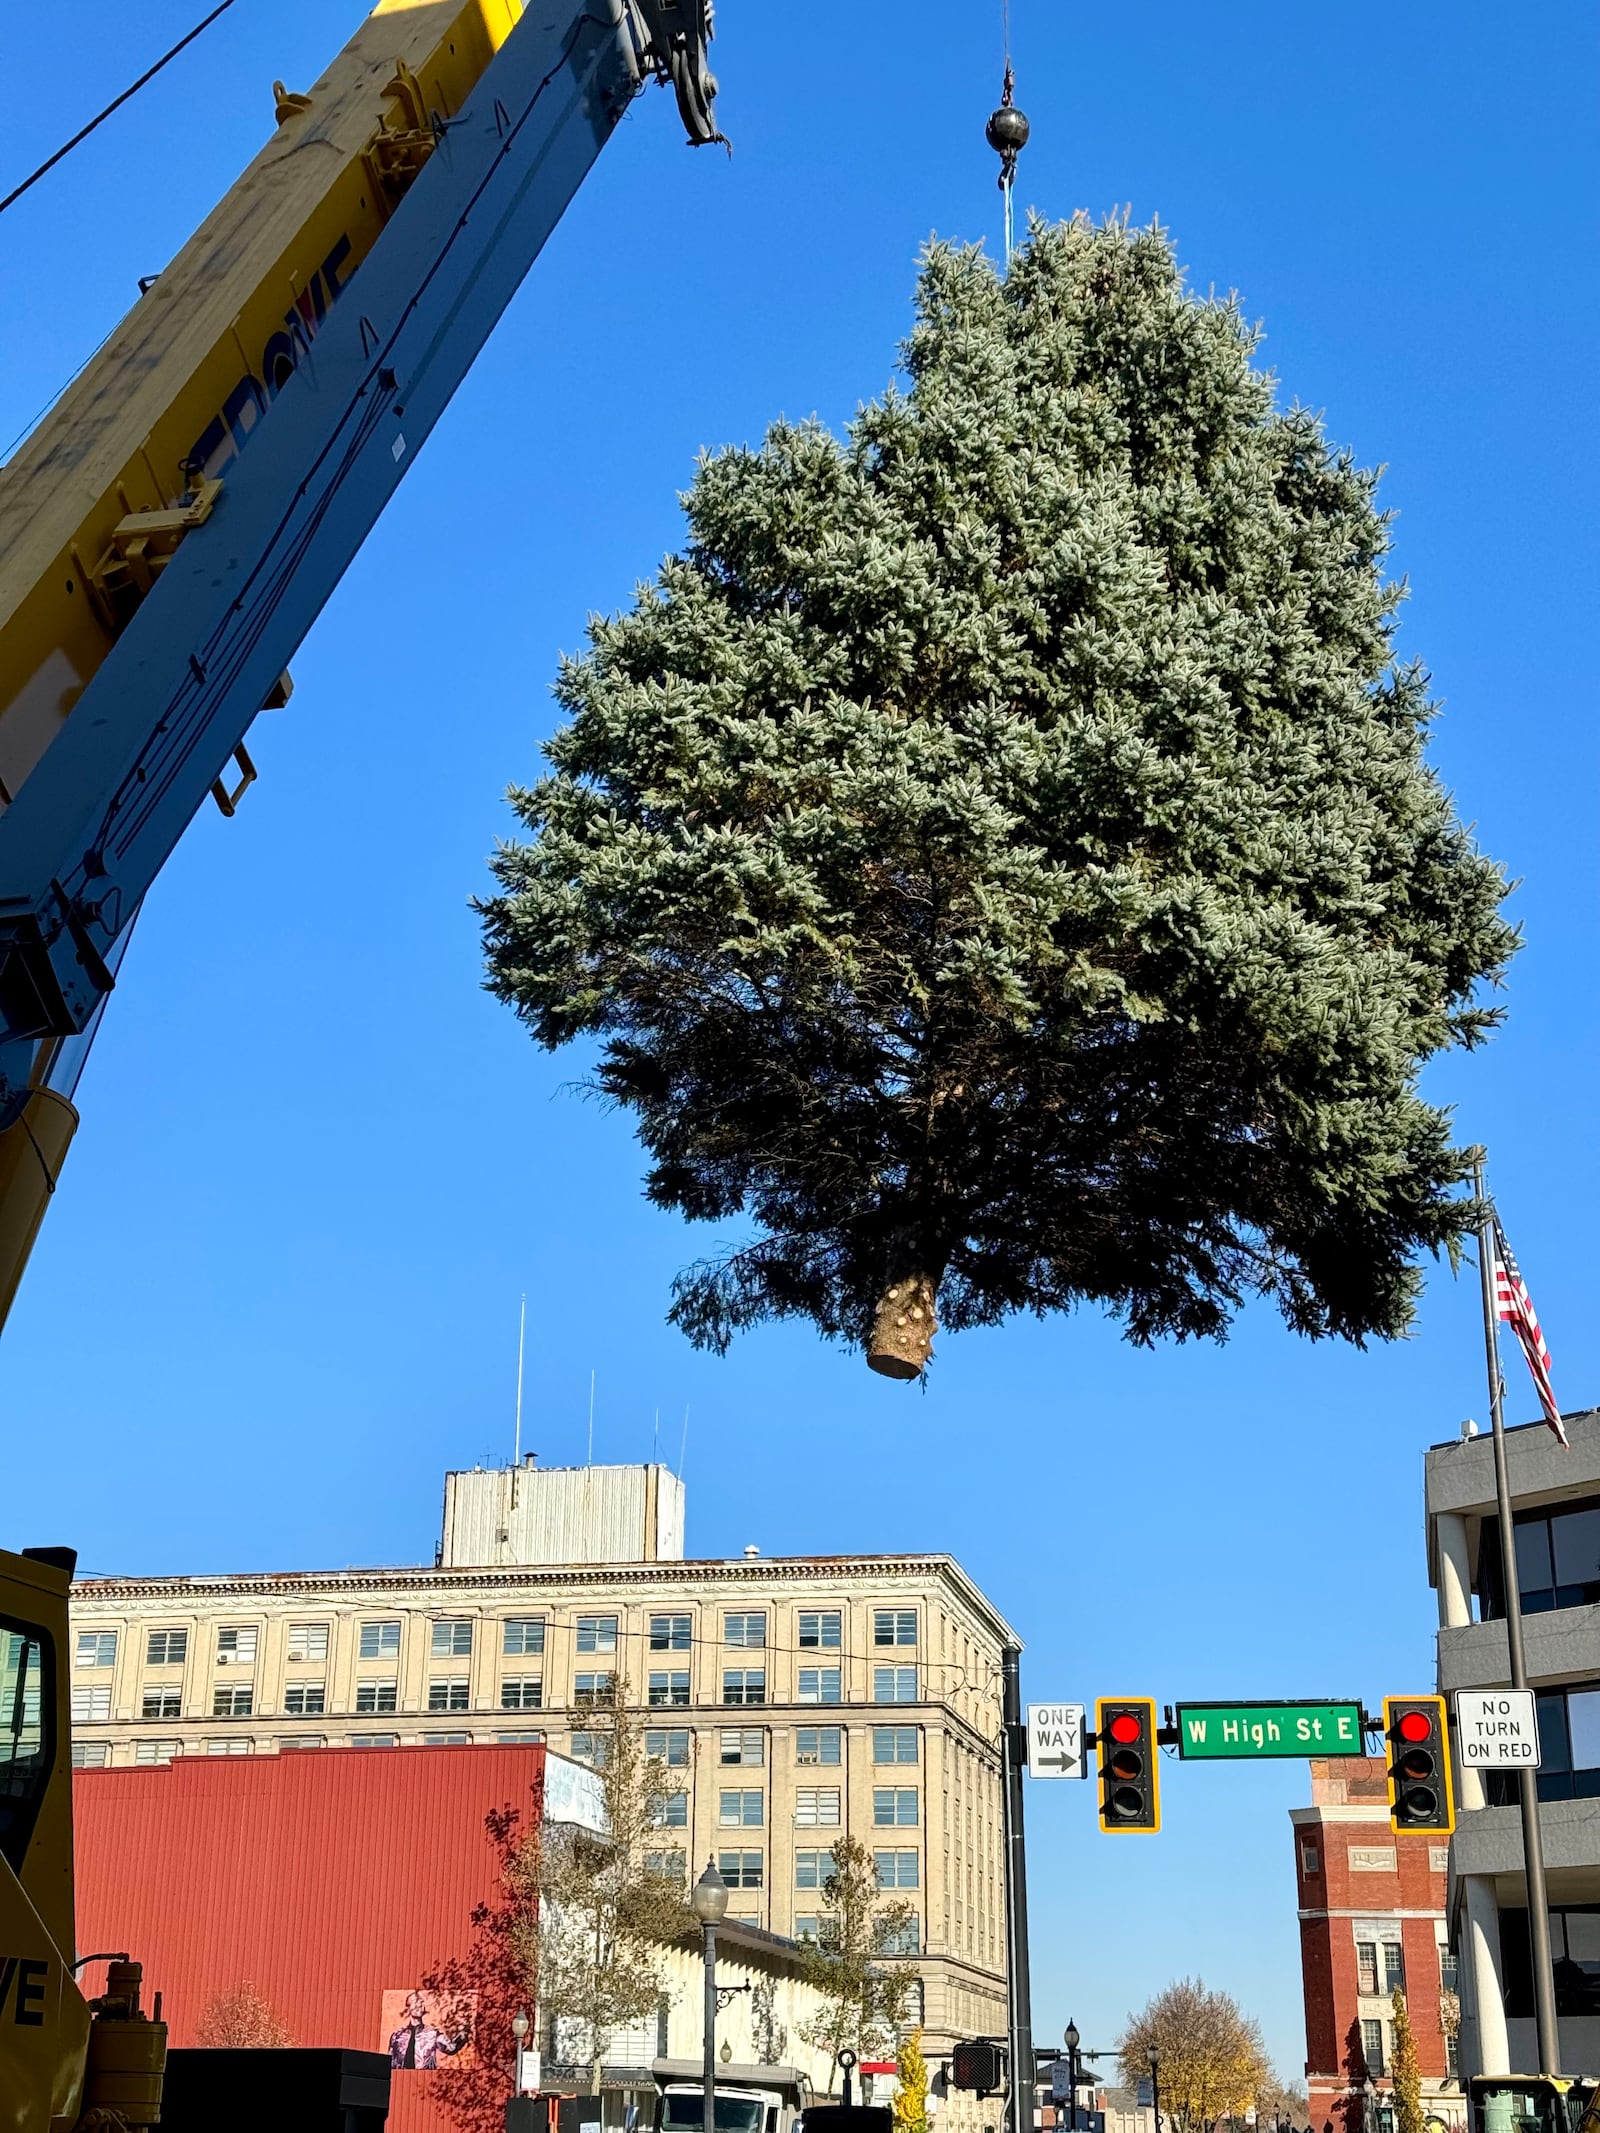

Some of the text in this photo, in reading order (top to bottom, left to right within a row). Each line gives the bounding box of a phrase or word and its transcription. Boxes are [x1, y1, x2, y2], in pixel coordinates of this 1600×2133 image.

[1482, 1700, 1510, 1715] NO
[1038, 1709, 1075, 1725] ONE
[1188, 1716, 1353, 1749] W High St E
[1475, 1721, 1520, 1736] TURN
[1037, 1730, 1077, 1746] WAY
[1468, 1743, 1532, 1757] ON RED
